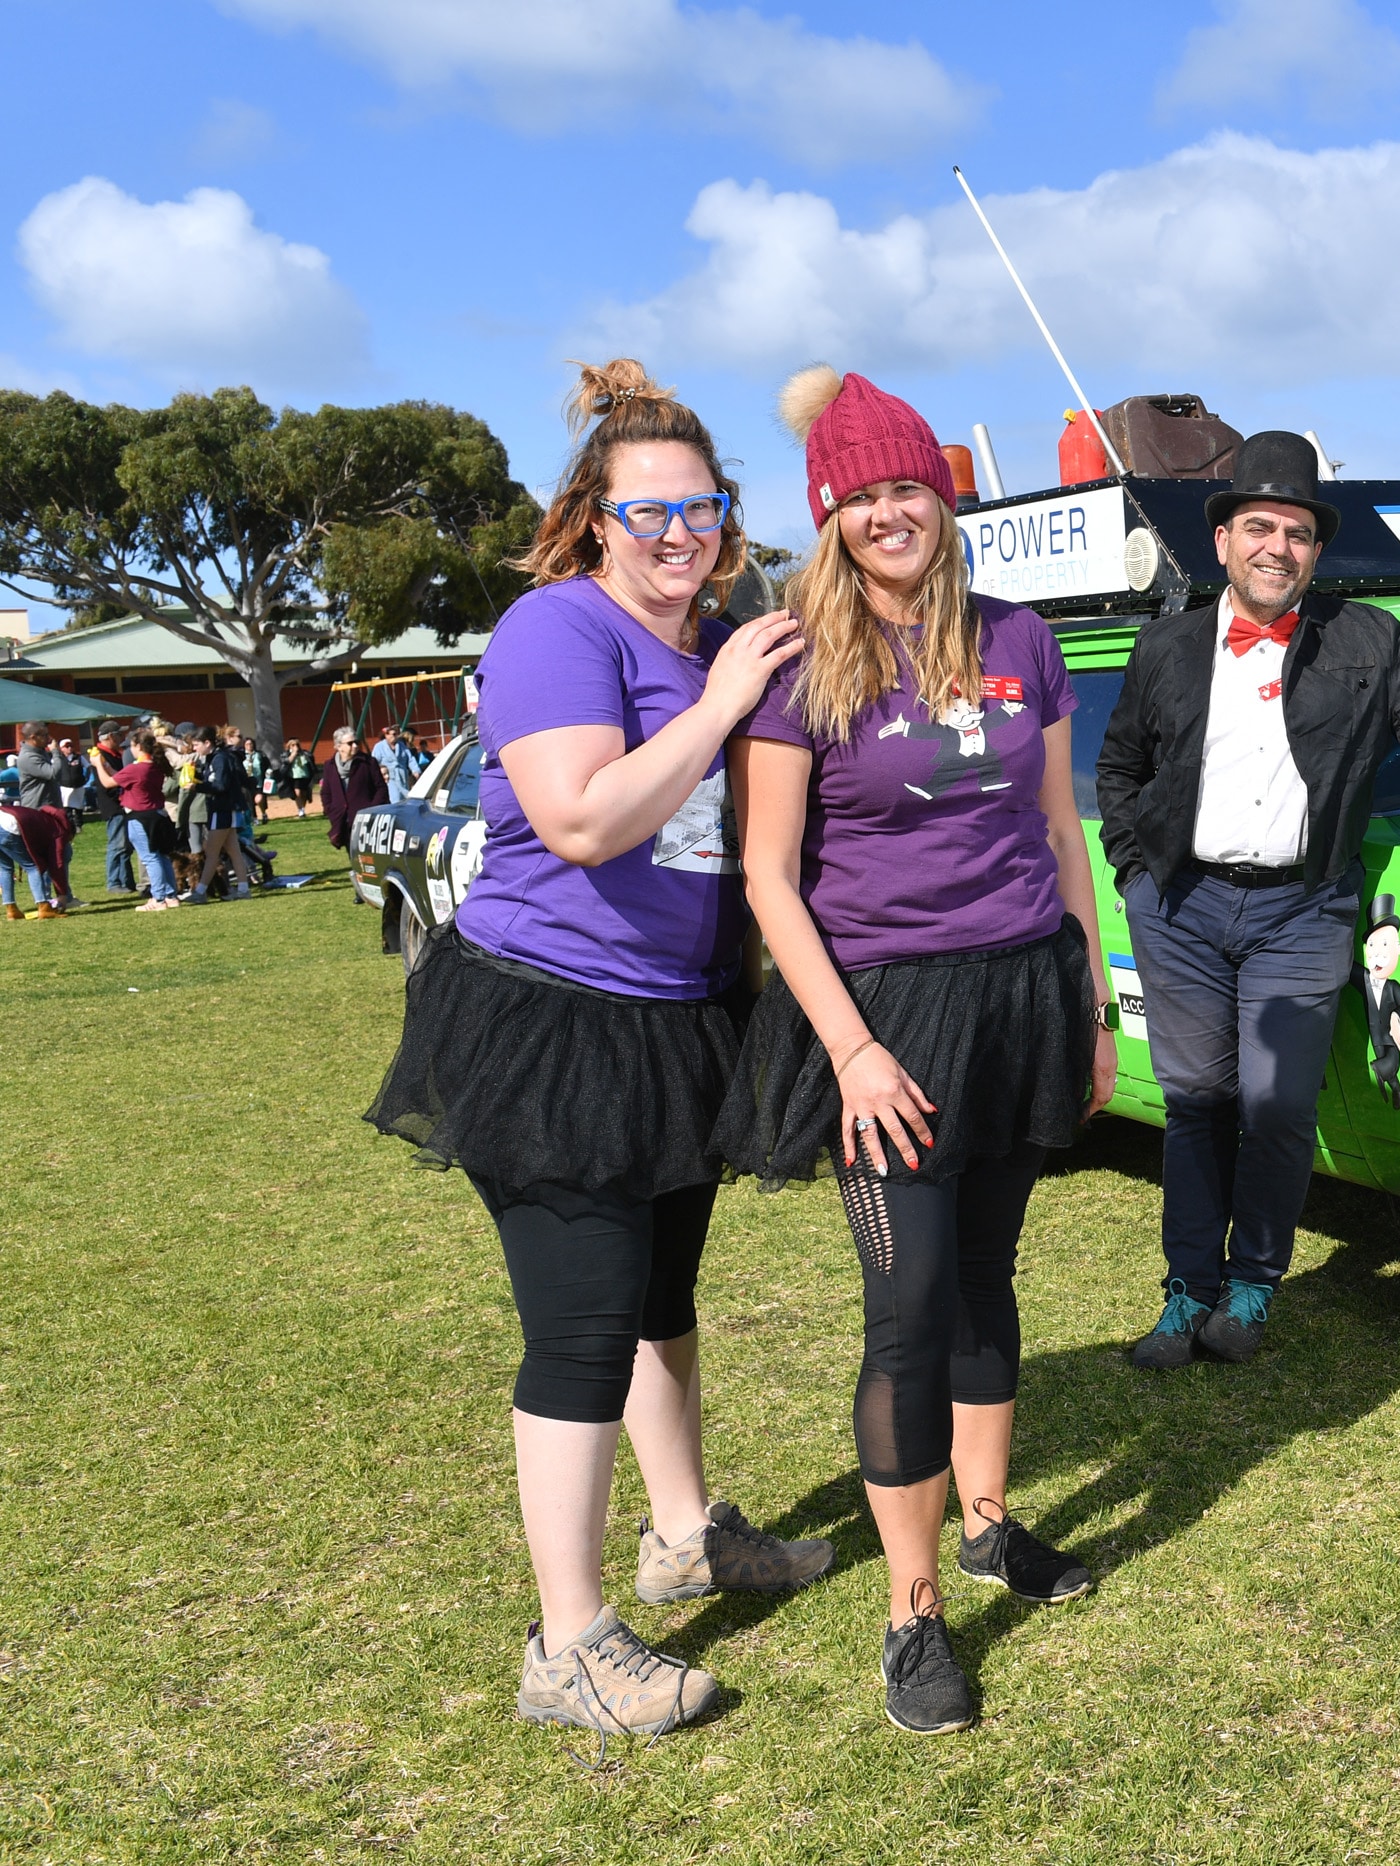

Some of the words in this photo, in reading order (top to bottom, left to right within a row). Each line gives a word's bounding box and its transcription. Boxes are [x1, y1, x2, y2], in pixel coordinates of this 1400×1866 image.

[980, 506, 1087, 565] POWER
[982, 579, 996, 596] OF
[1000, 559, 1089, 594] PROPERTY
[1122, 998, 1145, 1014] ACC
